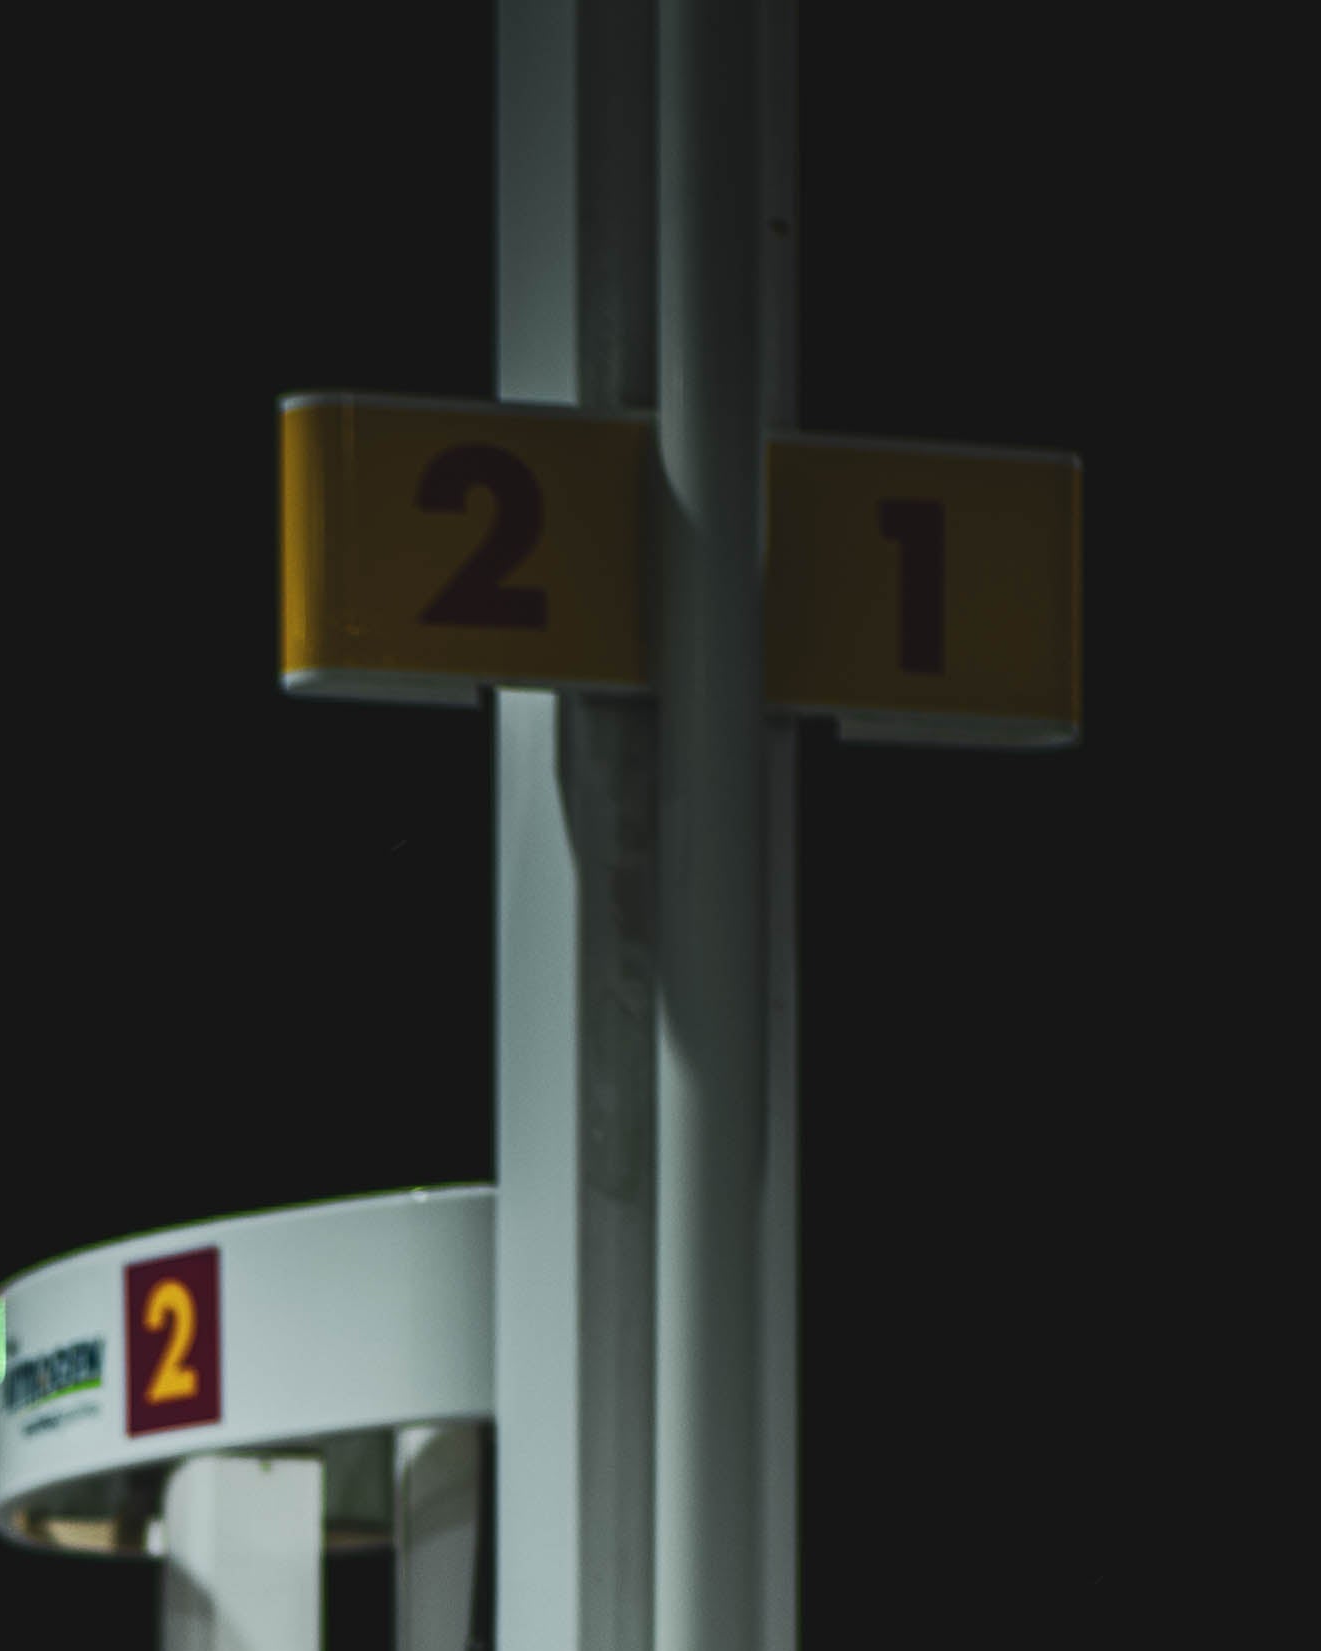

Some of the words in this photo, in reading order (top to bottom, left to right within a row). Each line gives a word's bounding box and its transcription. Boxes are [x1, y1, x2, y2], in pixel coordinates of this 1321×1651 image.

[413, 441, 547, 632] 2
[876, 498, 945, 675] 1
[144, 1279, 197, 1404] 2
